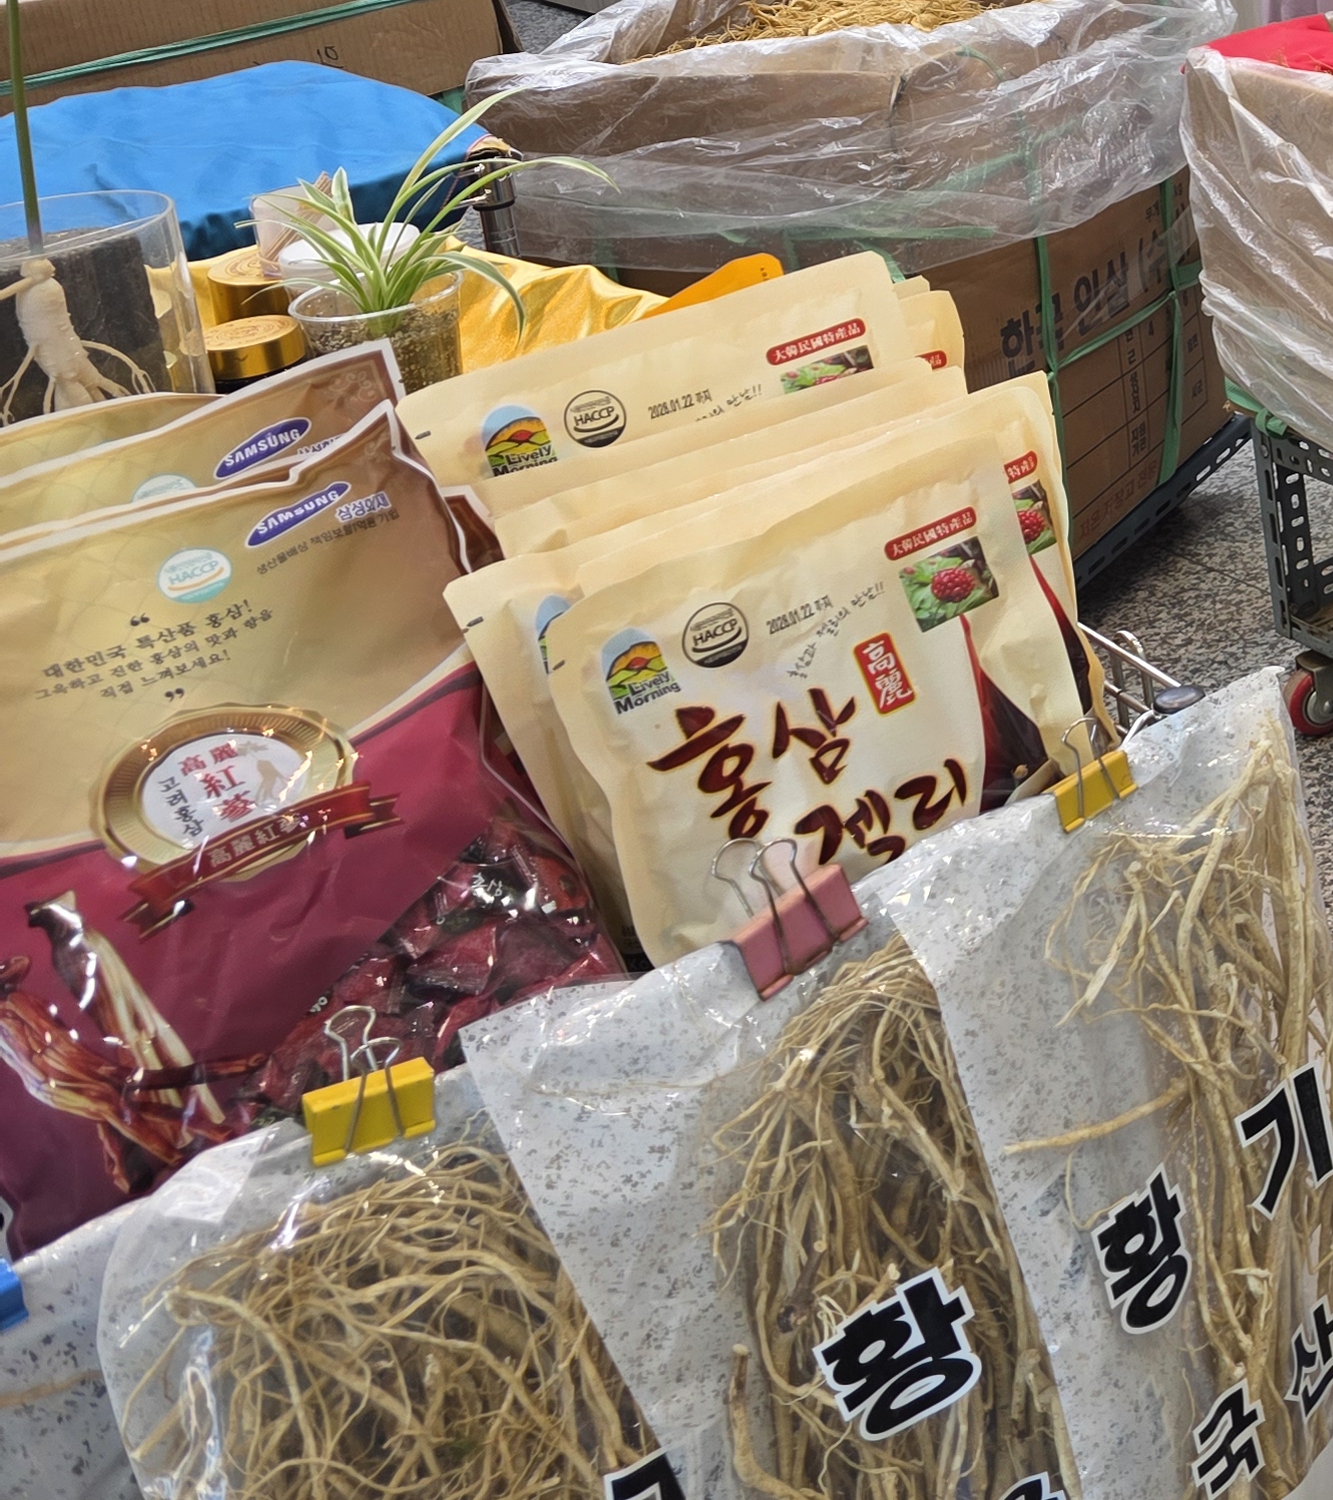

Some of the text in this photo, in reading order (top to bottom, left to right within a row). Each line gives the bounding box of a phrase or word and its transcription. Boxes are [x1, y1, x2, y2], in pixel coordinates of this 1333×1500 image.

[574, 406, 616, 428] HACCP
[225, 429, 301, 467] SAMSUNG
[505, 444, 553, 467] Lively
[256, 490, 339, 535] SAMSUNG
[337, 494, 390, 521] 삼성화재
[168, 558, 219, 588] HACCP
[257, 544, 309, 575] 생산물배상
[43, 599, 252, 679] 대한민국 특산품 홍삼!
[111, 660, 144, 678] 진한
[150, 640, 200, 665] 홍삼의
[205, 627, 239, 647] 맛과
[692, 619, 737, 648] HACCP
[101, 650, 231, 699] 직접 느껴보세요!
[629, 671, 671, 696] Lively
[862, 639, 914, 710] 高麗
[614, 681, 682, 715] Morning
[647, 687, 856, 841] 홍삼
[1098, 1172, 1189, 1330] 황
[822, 1275, 976, 1434] 황
[1195, 1385, 1264, 1496] 국
